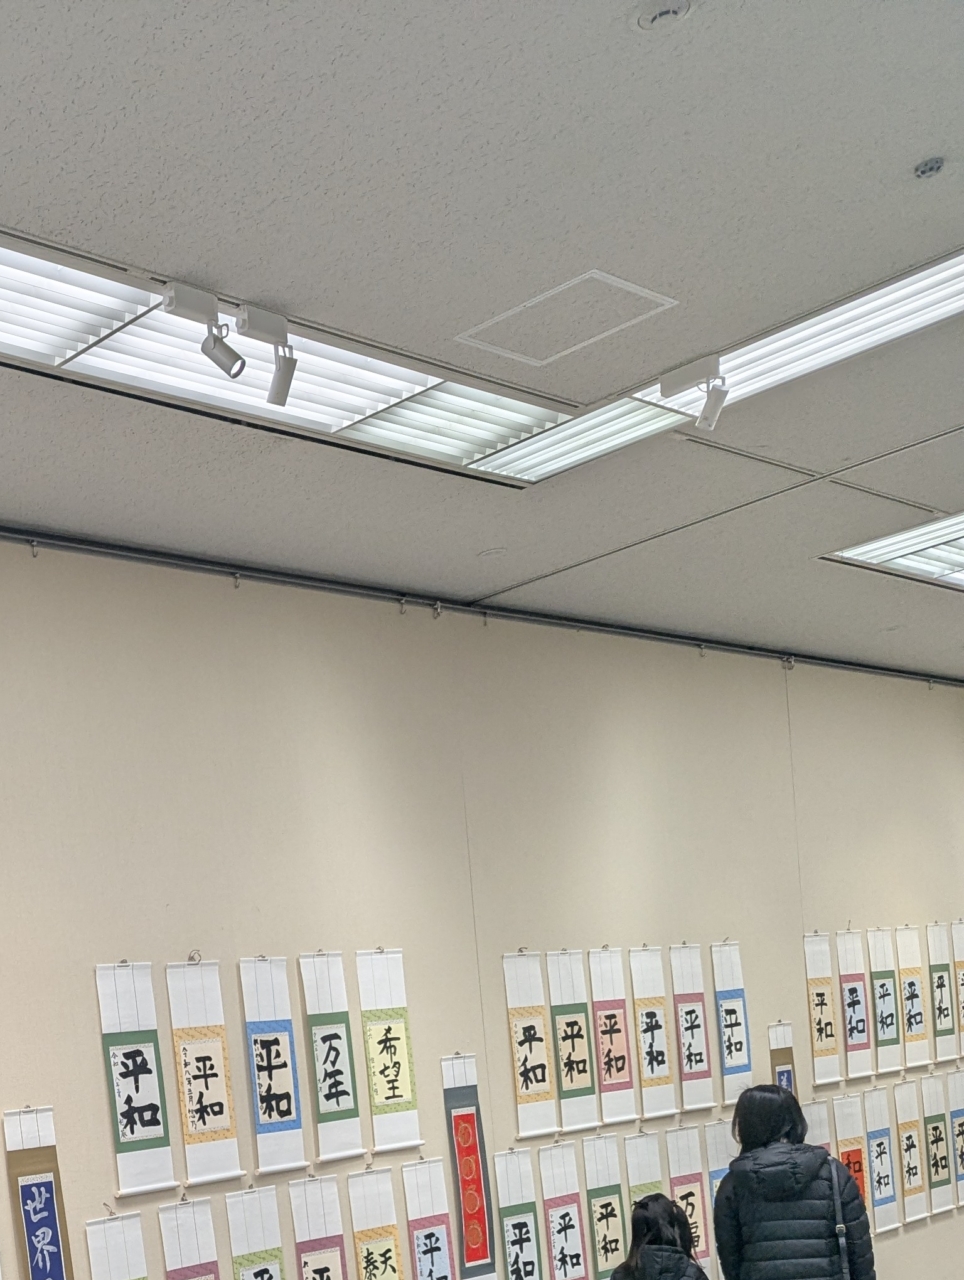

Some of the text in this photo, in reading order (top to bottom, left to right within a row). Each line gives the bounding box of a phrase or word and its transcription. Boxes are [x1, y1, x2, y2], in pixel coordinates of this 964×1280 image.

[814, 992, 834, 1042] 平和
[847, 987, 865, 1040] 平和
[878, 983, 894, 1035] 平和
[906, 981, 923, 1033] 平和
[936, 975, 950, 1025] 平和
[377, 1025, 403, 1100] 希望
[517, 1025, 547, 1091] 平和
[561, 1020, 588, 1084] 平和
[600, 1014, 626, 1079] 平和
[642, 1011, 666, 1075] 平和
[684, 1009, 704, 1070] 平和
[724, 1008, 743, 1060] 平和
[119, 1049, 161, 1135] 平和
[192, 1055, 222, 1126] 平和
[256, 1037, 292, 1119] 平和
[320, 1033, 350, 1107] 万年
[874, 1141, 890, 1195] 平和
[904, 1134, 918, 1186] 平和
[931, 1125, 948, 1176] 平和
[556, 1211, 581, 1278] 平和
[597, 1201, 620, 1263] 平和
